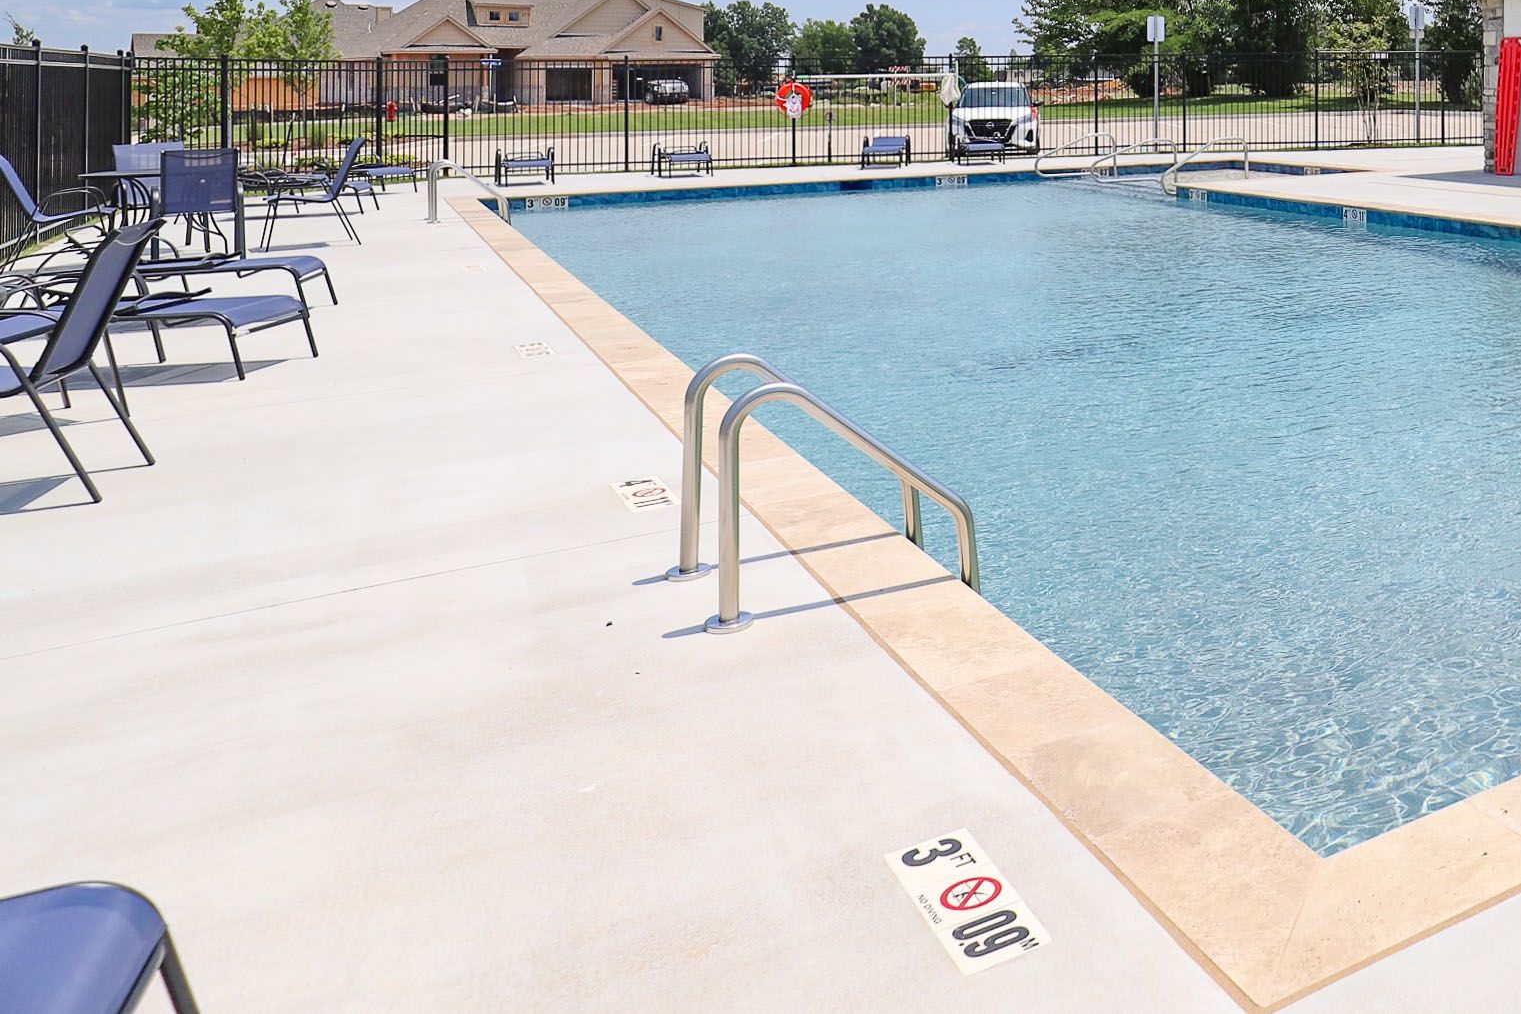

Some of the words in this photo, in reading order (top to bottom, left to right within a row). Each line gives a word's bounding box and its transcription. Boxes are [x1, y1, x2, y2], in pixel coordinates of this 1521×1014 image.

[527, 199, 534, 208] 3
[901, 838, 963, 868] 3
[950, 852, 977, 868] FT
